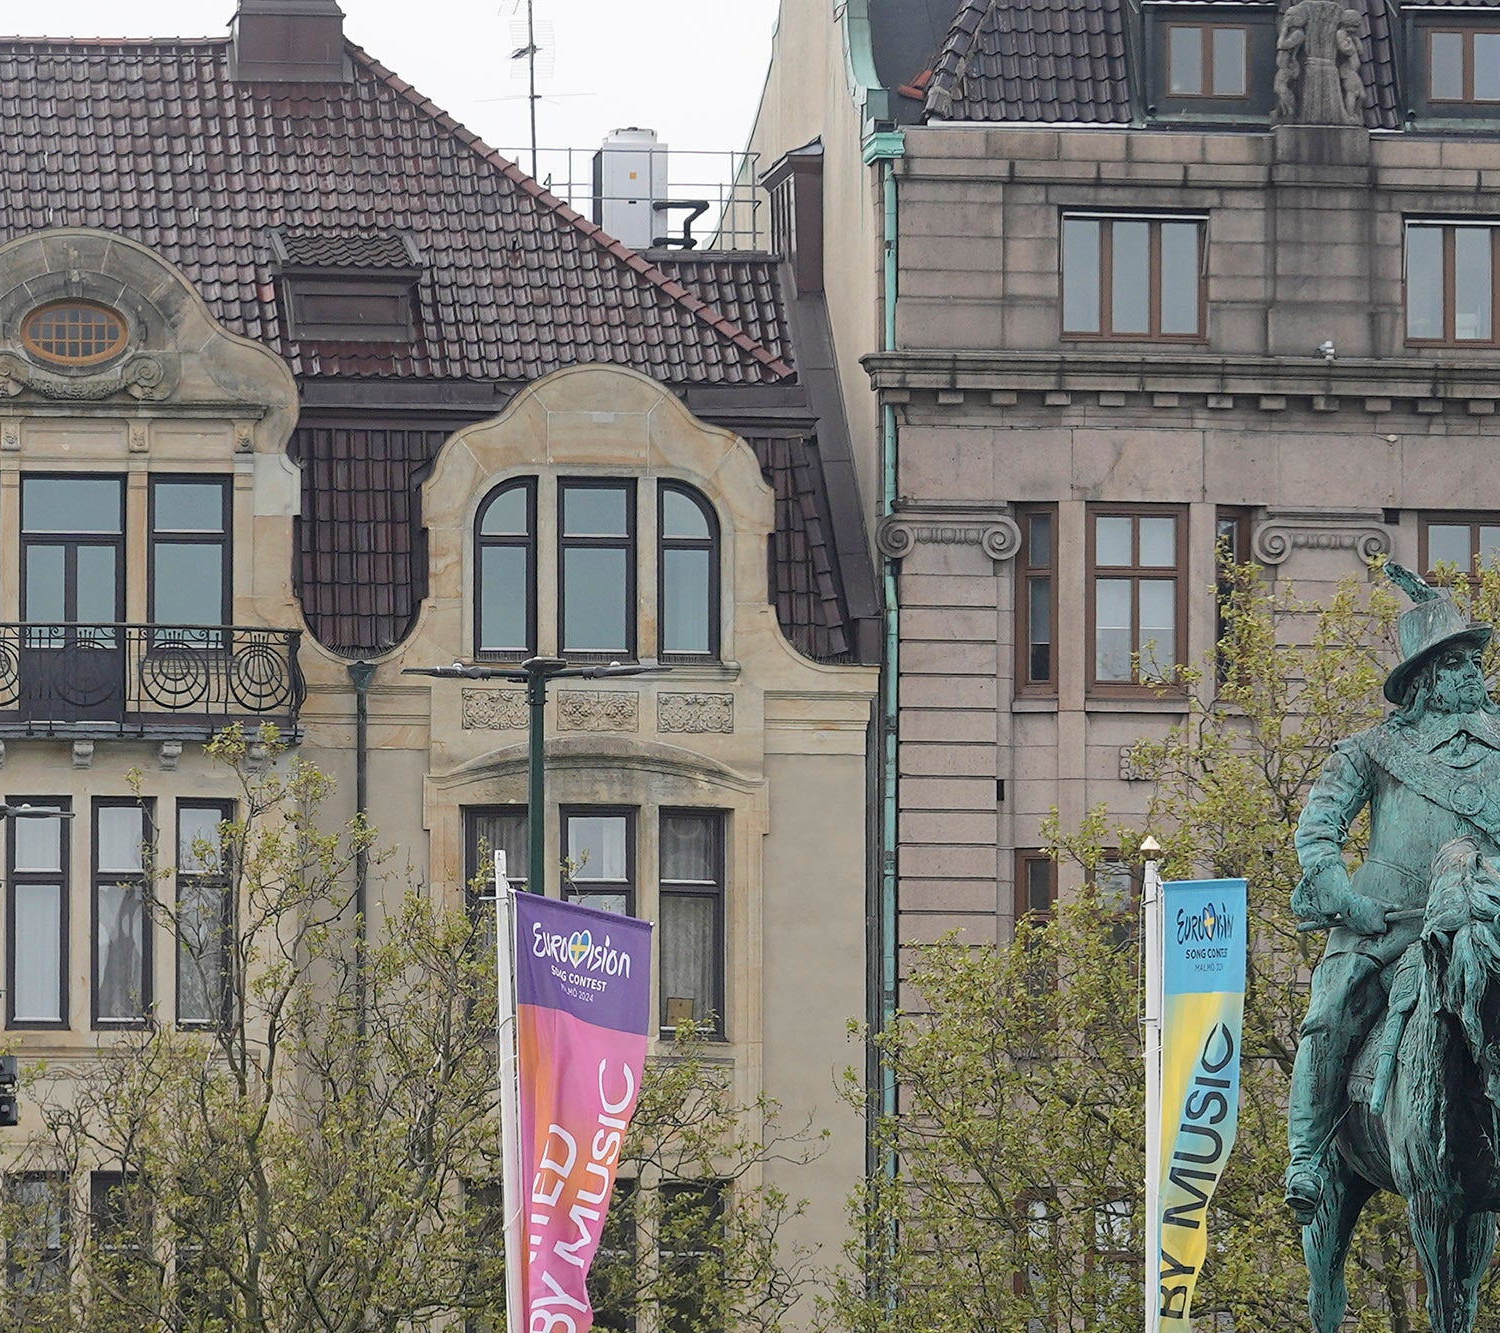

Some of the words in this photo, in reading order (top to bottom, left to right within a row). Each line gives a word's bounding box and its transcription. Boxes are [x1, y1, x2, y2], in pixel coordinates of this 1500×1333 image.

[568, 971, 607, 993] CONTEST
[1185, 948, 1206, 959] SONG
[1163, 1021, 1234, 1230] MUSIC
[553, 1058, 635, 1268] MUSIC
[1161, 1250, 1195, 1320] BY
